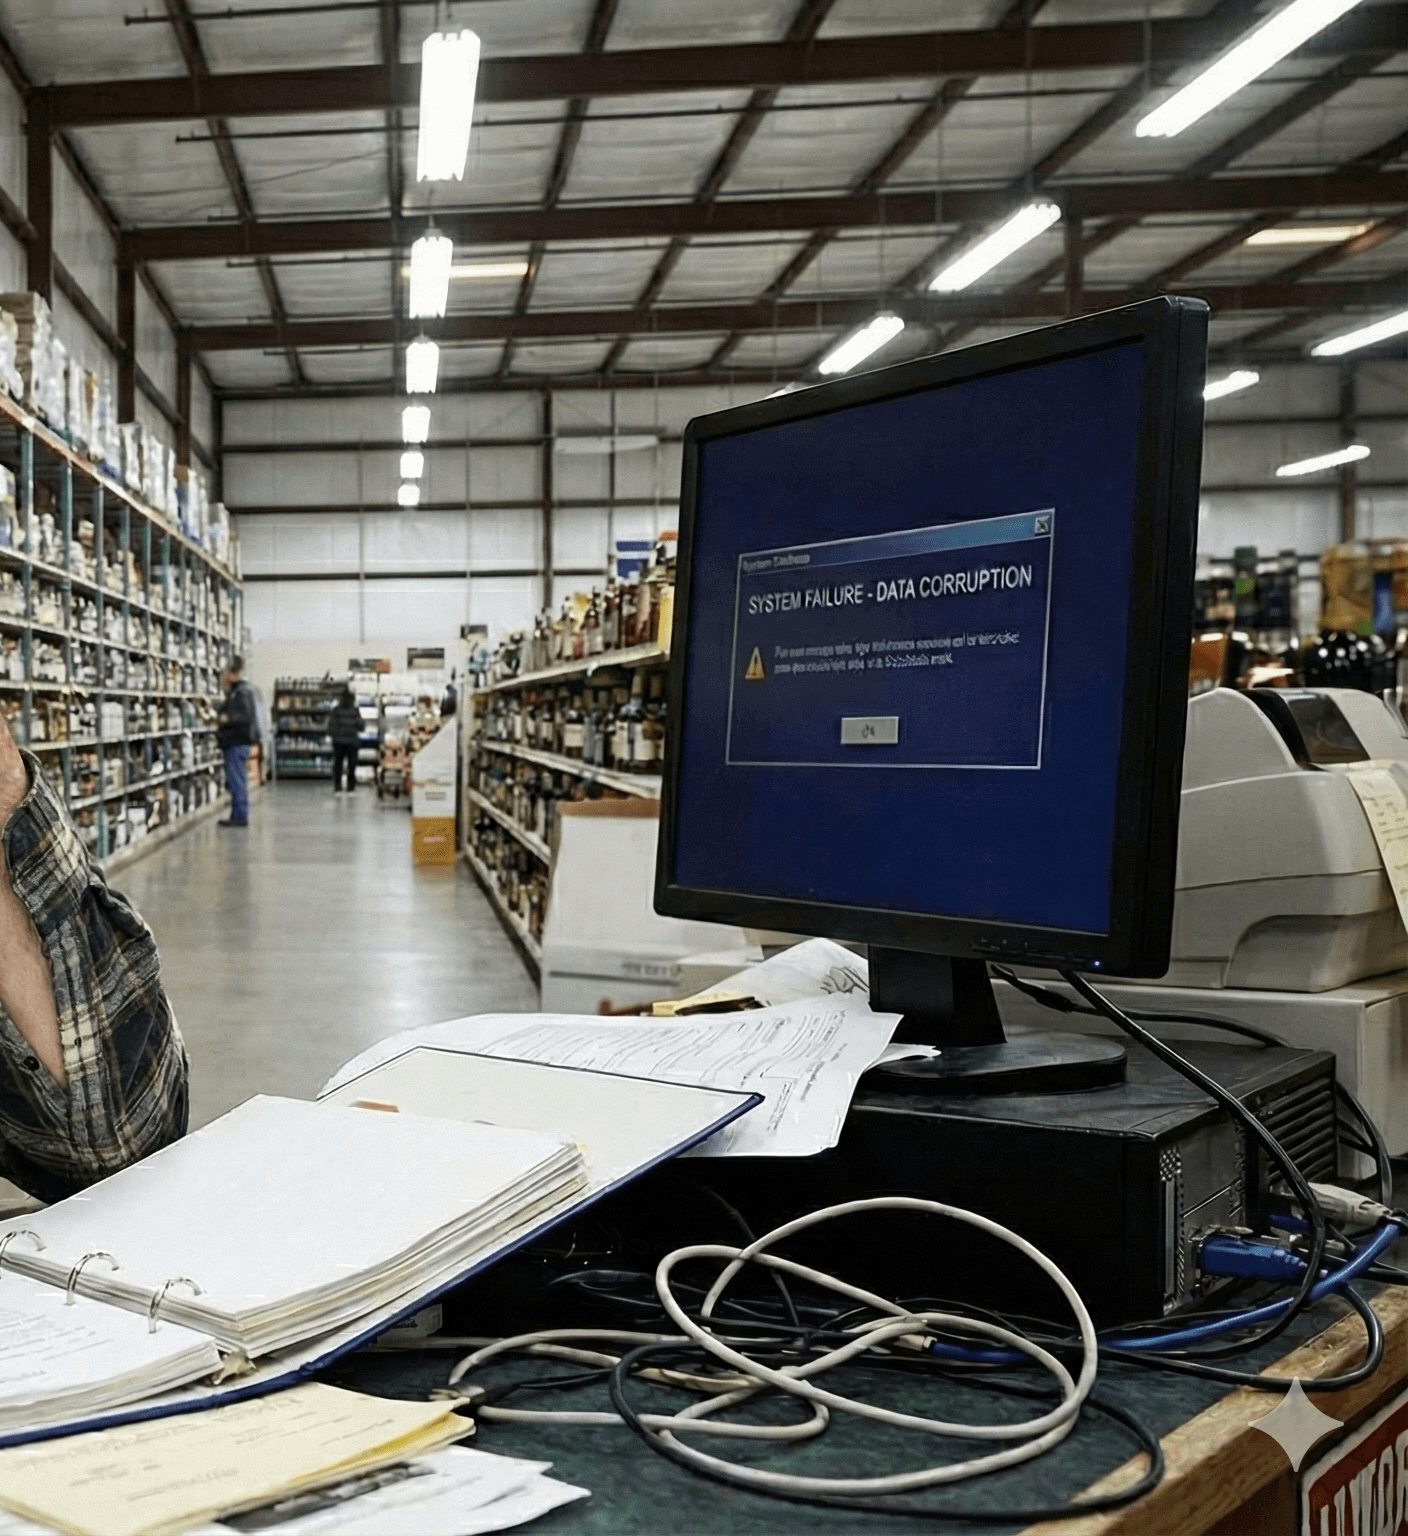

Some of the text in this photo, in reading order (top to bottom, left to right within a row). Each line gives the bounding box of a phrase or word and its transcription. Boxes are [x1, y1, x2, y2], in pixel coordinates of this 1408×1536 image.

[748, 591, 802, 615] SYSTEM
[804, 583, 864, 609] FAILURE
[876, 578, 916, 602] DATA
[919, 564, 1032, 598] CORRUPTION
